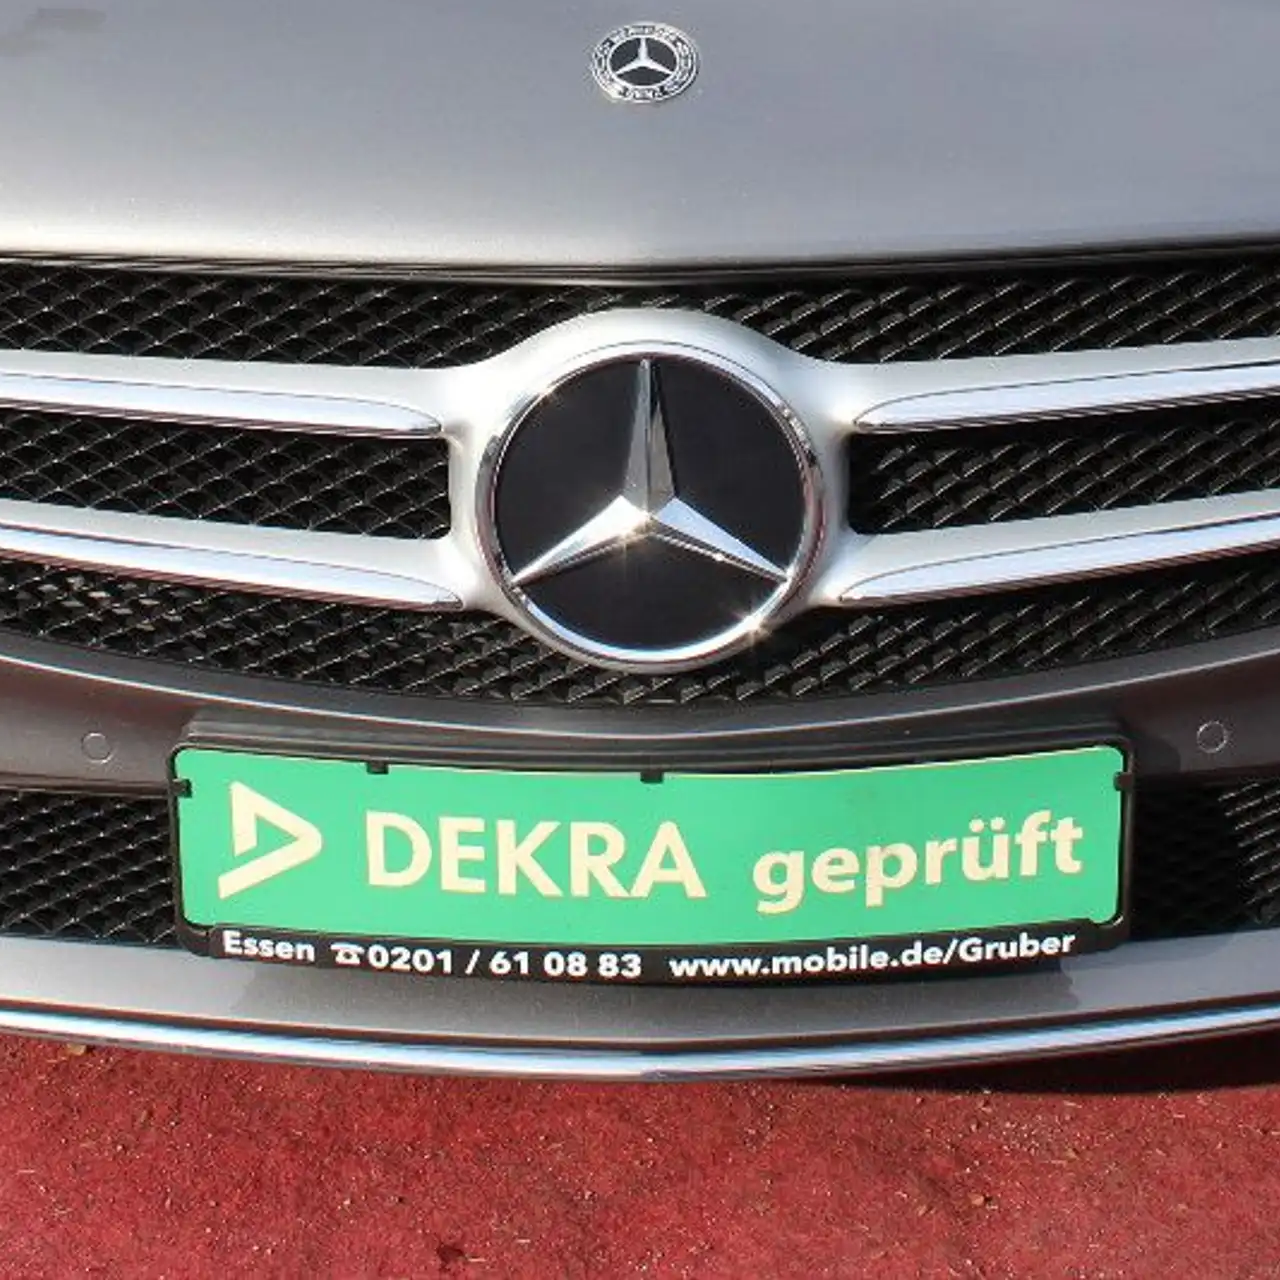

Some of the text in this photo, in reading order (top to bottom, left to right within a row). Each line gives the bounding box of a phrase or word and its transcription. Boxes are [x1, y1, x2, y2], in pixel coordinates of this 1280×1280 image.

[366, 809, 1084, 914] DEKRA geprüft
[222, 929, 315, 963] Essen
[368, 947, 452, 974] 0201
[489, 951, 529, 975] 61
[543, 952, 587, 977] 08
[597, 953, 641, 978] 83
[668, 930, 1076, 978] www.mobile.de/Gruber
